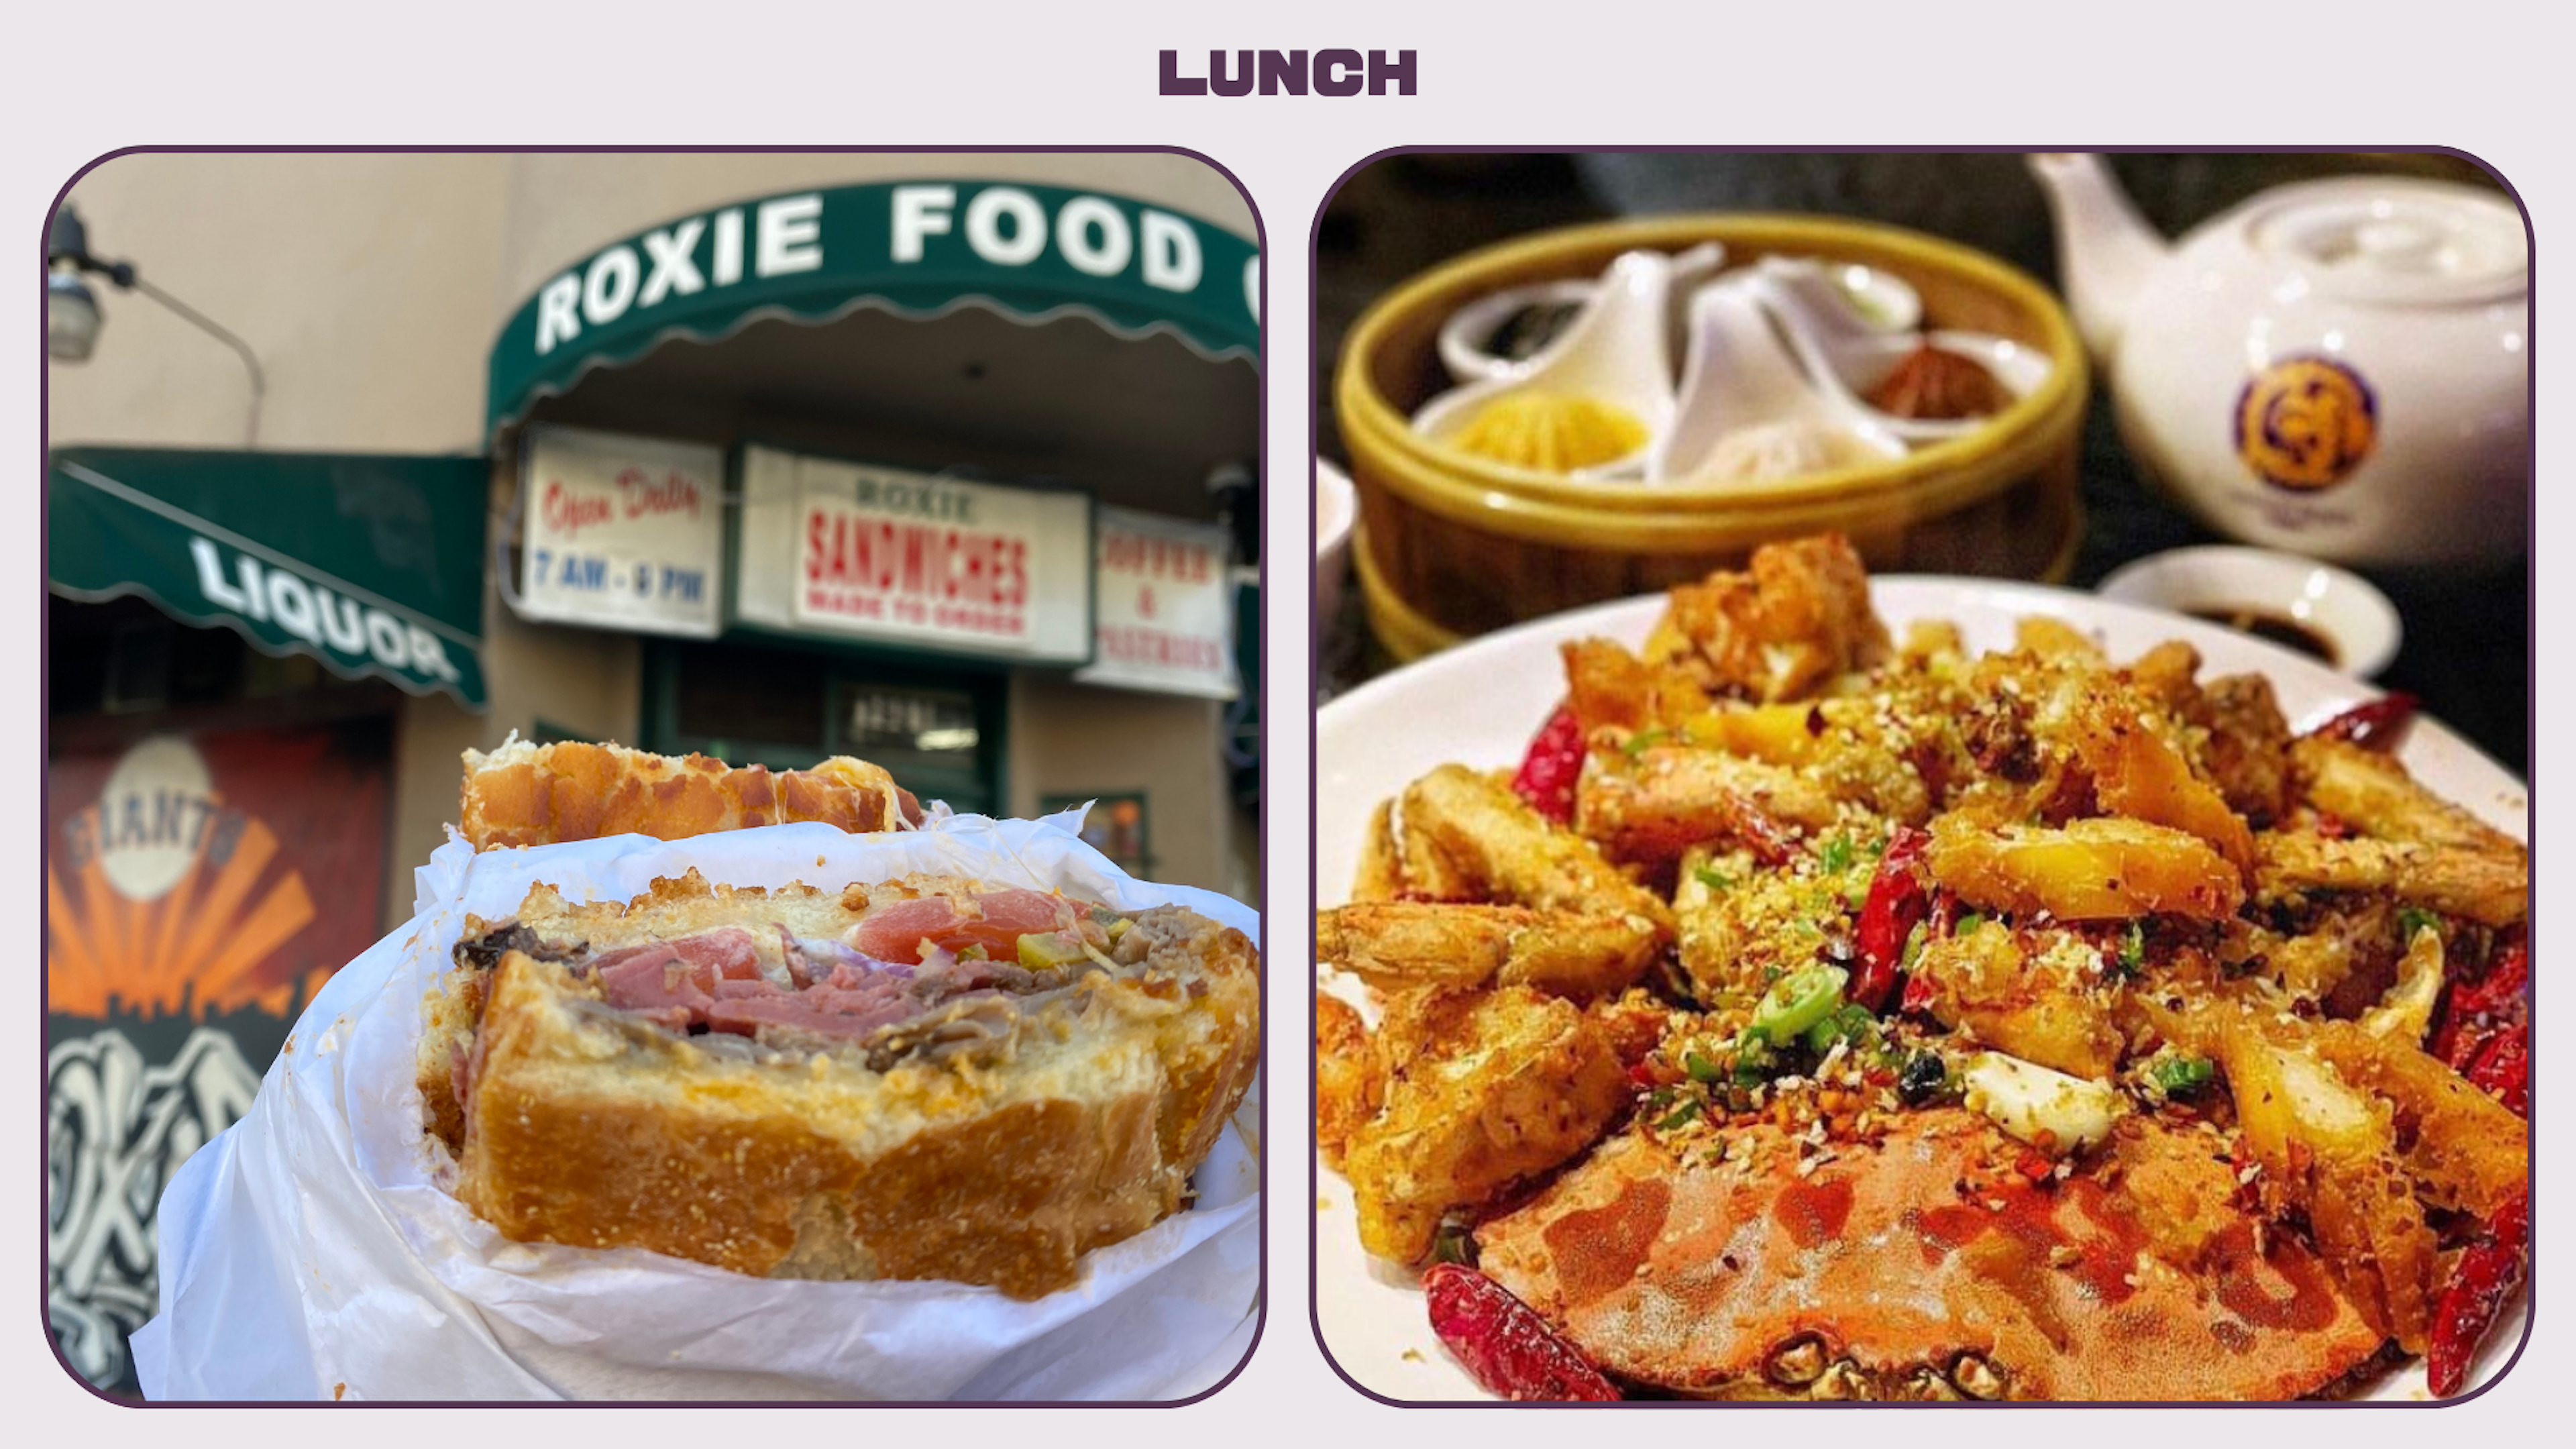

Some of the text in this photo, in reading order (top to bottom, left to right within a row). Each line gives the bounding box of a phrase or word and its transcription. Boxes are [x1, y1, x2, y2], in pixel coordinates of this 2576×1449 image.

[535, 193, 824, 356] ROXIE
[890, 184, 1203, 294] FOOD
[856, 478, 977, 523] ROXIE
[535, 550, 551, 588] 7
[561, 555, 607, 591] AM
[661, 567, 704, 601] PM
[807, 509, 1028, 608] SANDWICHES
[189, 535, 463, 684] LIQUOR
[807, 589, 1027, 638] MADE TO ORDER
[62, 786, 247, 868] GIANTS
